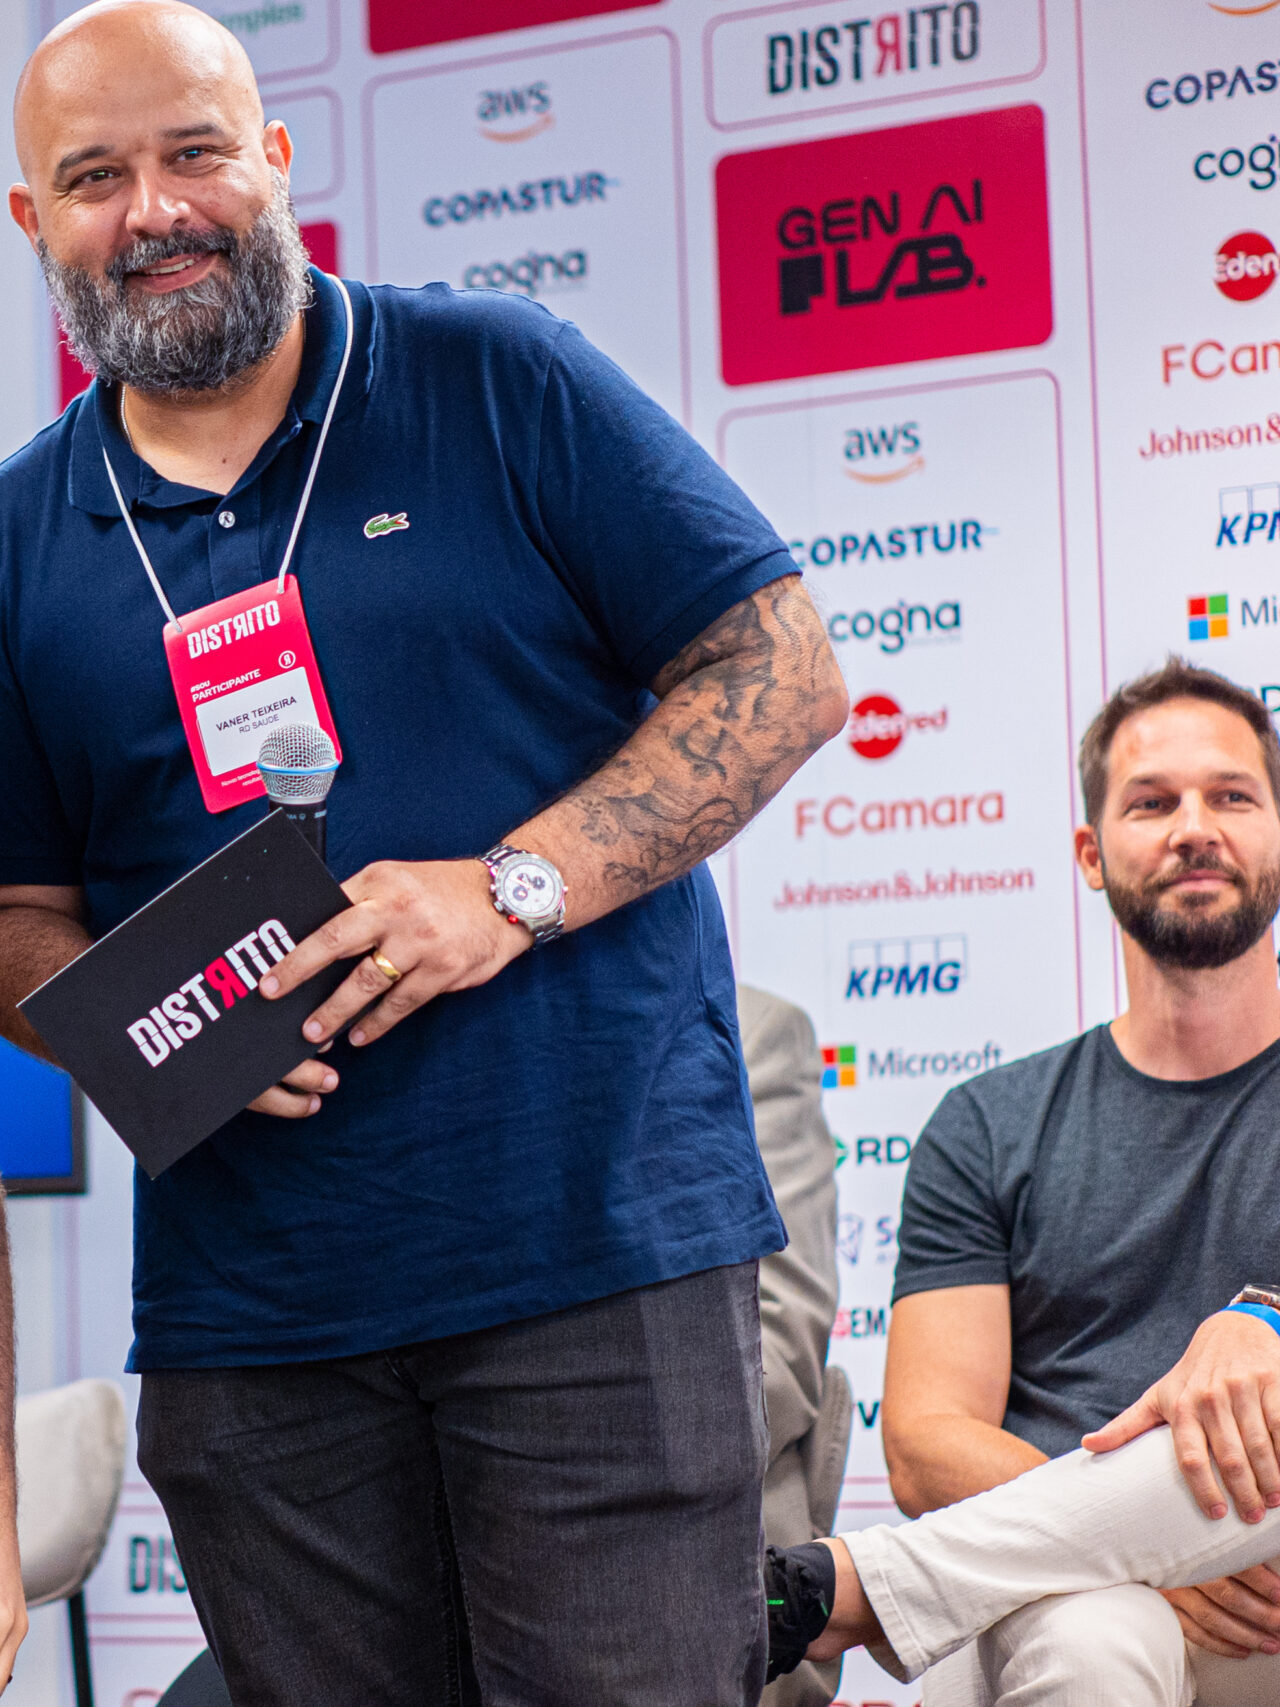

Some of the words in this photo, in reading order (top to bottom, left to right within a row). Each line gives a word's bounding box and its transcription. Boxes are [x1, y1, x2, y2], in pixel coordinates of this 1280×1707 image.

[477, 81, 552, 121] aws
[1145, 60, 1280, 110] COPAS
[1193, 133, 1280, 190] cog
[423, 171, 608, 227] COPASTUR
[777, 190, 900, 250] GEN
[921, 178, 985, 230] AI
[844, 421, 921, 461] aws
[829, 596, 961, 654] cogna
[192, 668, 261, 702] PARTICIPANTE
[216, 713, 250, 732] VANER
[251, 695, 297, 719] TEIXEIRA
[795, 791, 1004, 840] FCamara
[773, 868, 1034, 907] Johnson&Johnson
[845, 961, 961, 1000] KPMG
[868, 1042, 1002, 1078] Microsoft
[856, 1136, 911, 1164] RD
